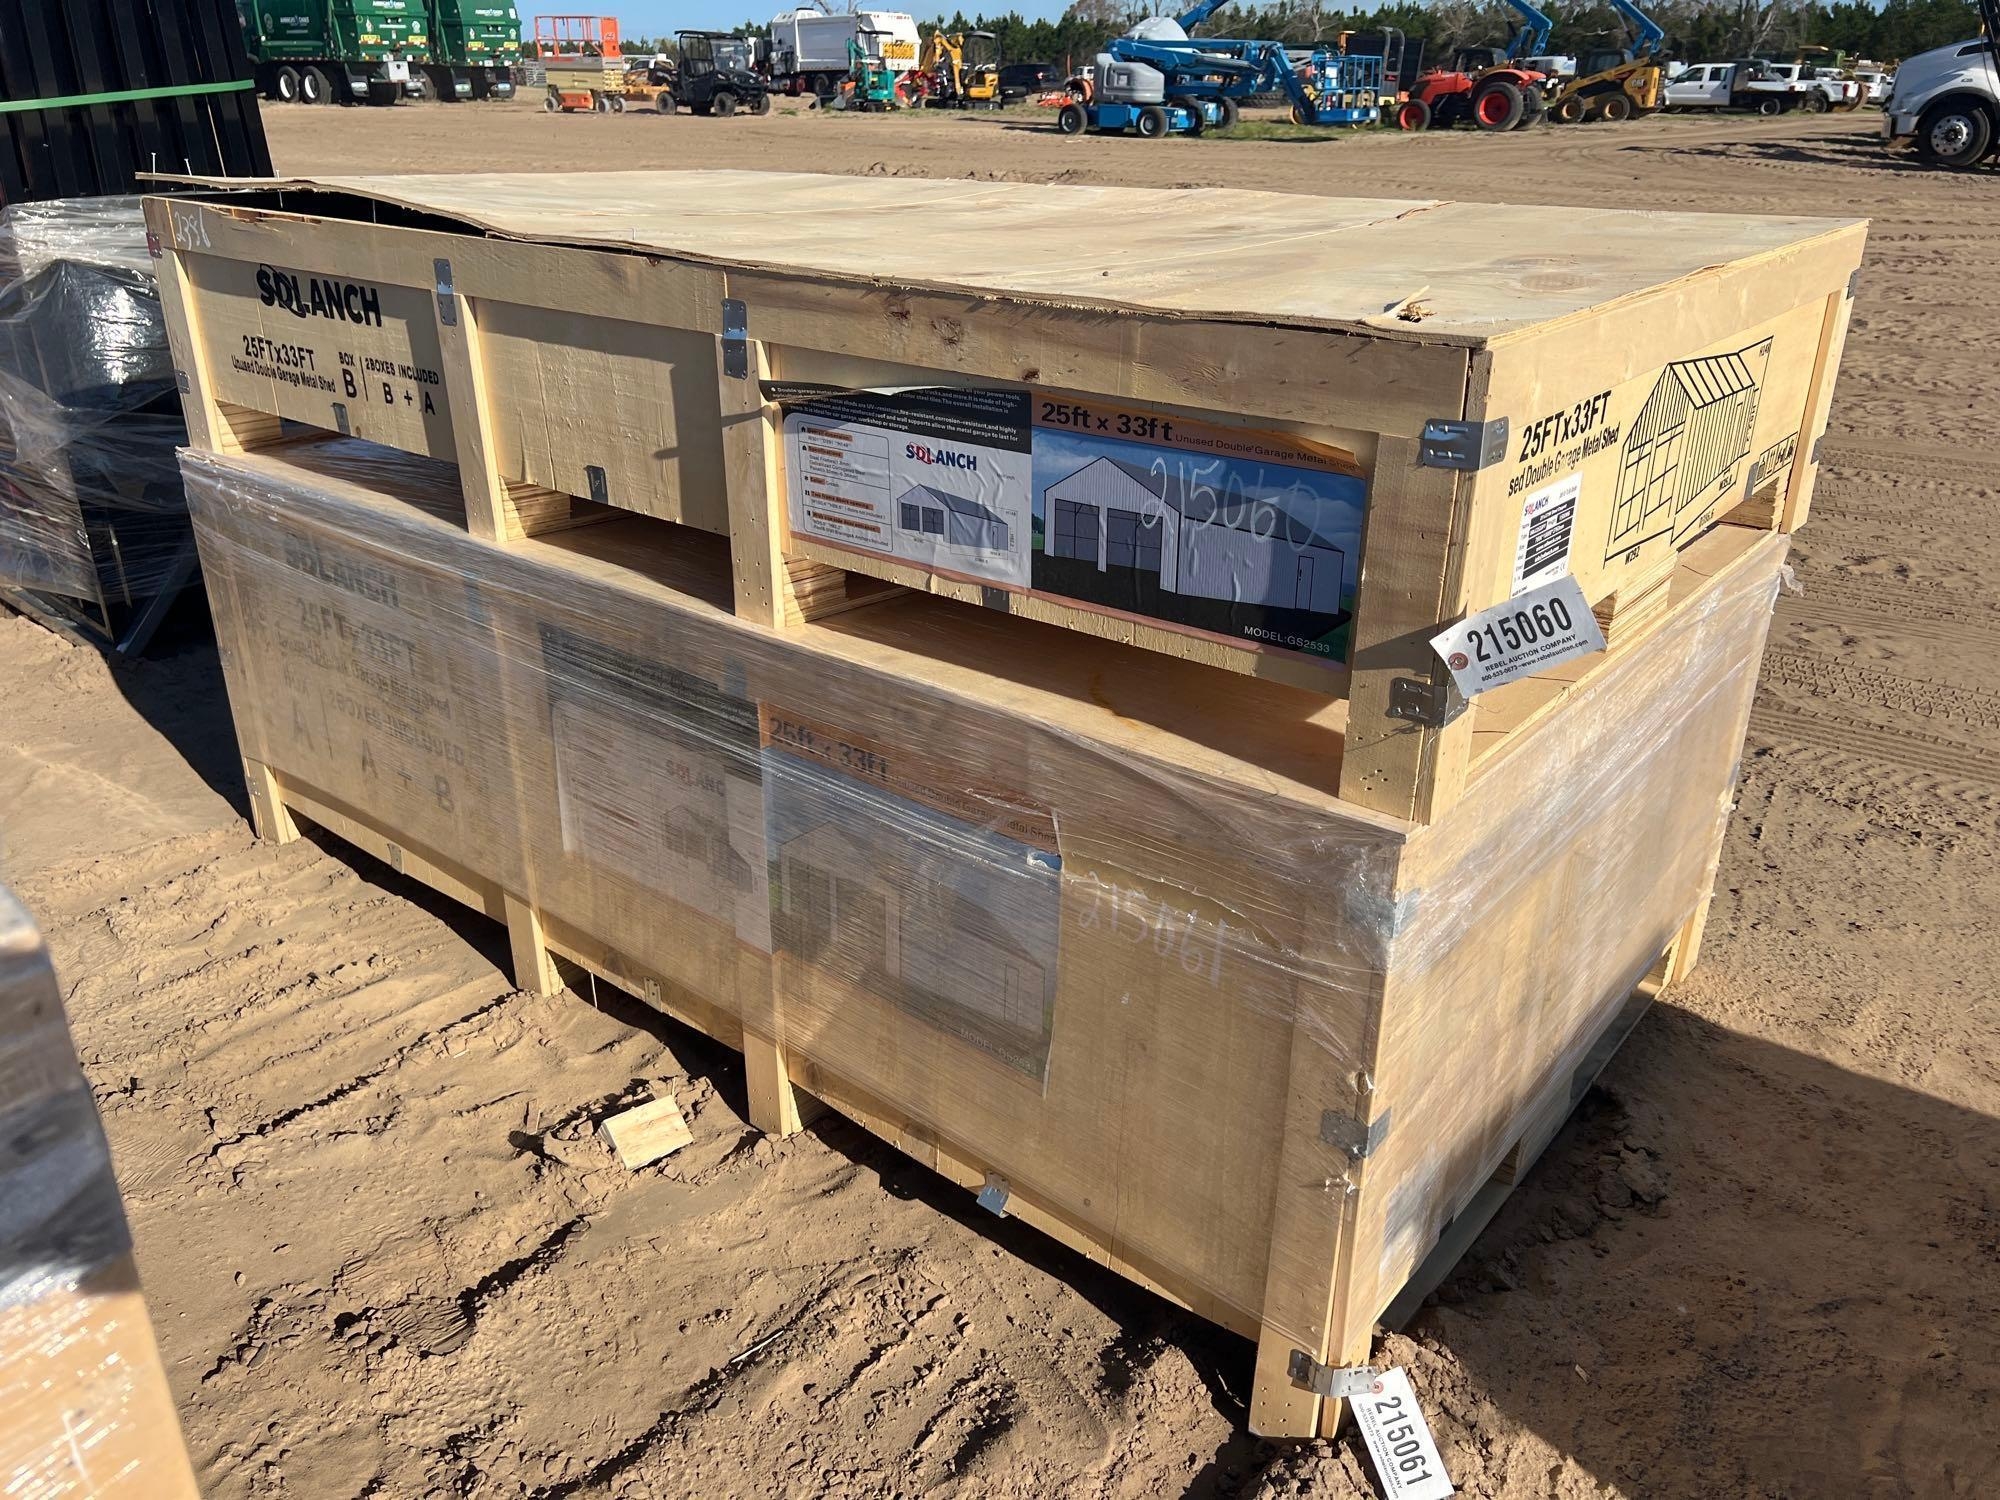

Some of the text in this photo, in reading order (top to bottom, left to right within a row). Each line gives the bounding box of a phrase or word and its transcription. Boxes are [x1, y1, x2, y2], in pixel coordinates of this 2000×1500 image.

[255, 263, 382, 327] SOLANCH
[242, 334, 315, 371] 25FTx33FT
[338, 351, 356, 367] BOX
[364, 357, 439, 385] 2BOXES INCLUDED
[342, 368, 357, 398] B
[382, 382, 394, 404] B
[424, 391, 436, 415] A
[946, 423, 956, 431] the
[956, 426, 972, 434] metal
[1040, 401, 1091, 430] 25ft
[1096, 416, 1109, 430] x
[1116, 413, 1173, 442] 33ft
[1175, 434, 1214, 448] Unused
[1215, 440, 1252, 453] Double
[1254, 446, 1294, 461] Garage
[1296, 452, 1328, 465] Metal
[1518, 389, 1612, 463] 25FTx33FT
[905, 441, 977, 471] SOLANCH
[1524, 456, 1554, 488] Double
[1581, 430, 1603, 460] Metal
[1601, 421, 1621, 450] Shed
[1139, 456, 1320, 552] 215060
[1243, 625, 1331, 654] MODEL:GS2533
[1466, 597, 1573, 662] 215060
[1485, 633, 1577, 672] REBEL AUCTION COMPANY
[1374, 1396, 1432, 1485] 215061
[1375, 1429, 1390, 1457] AUCTION
[1386, 1457, 1403, 1489] COMPANY
